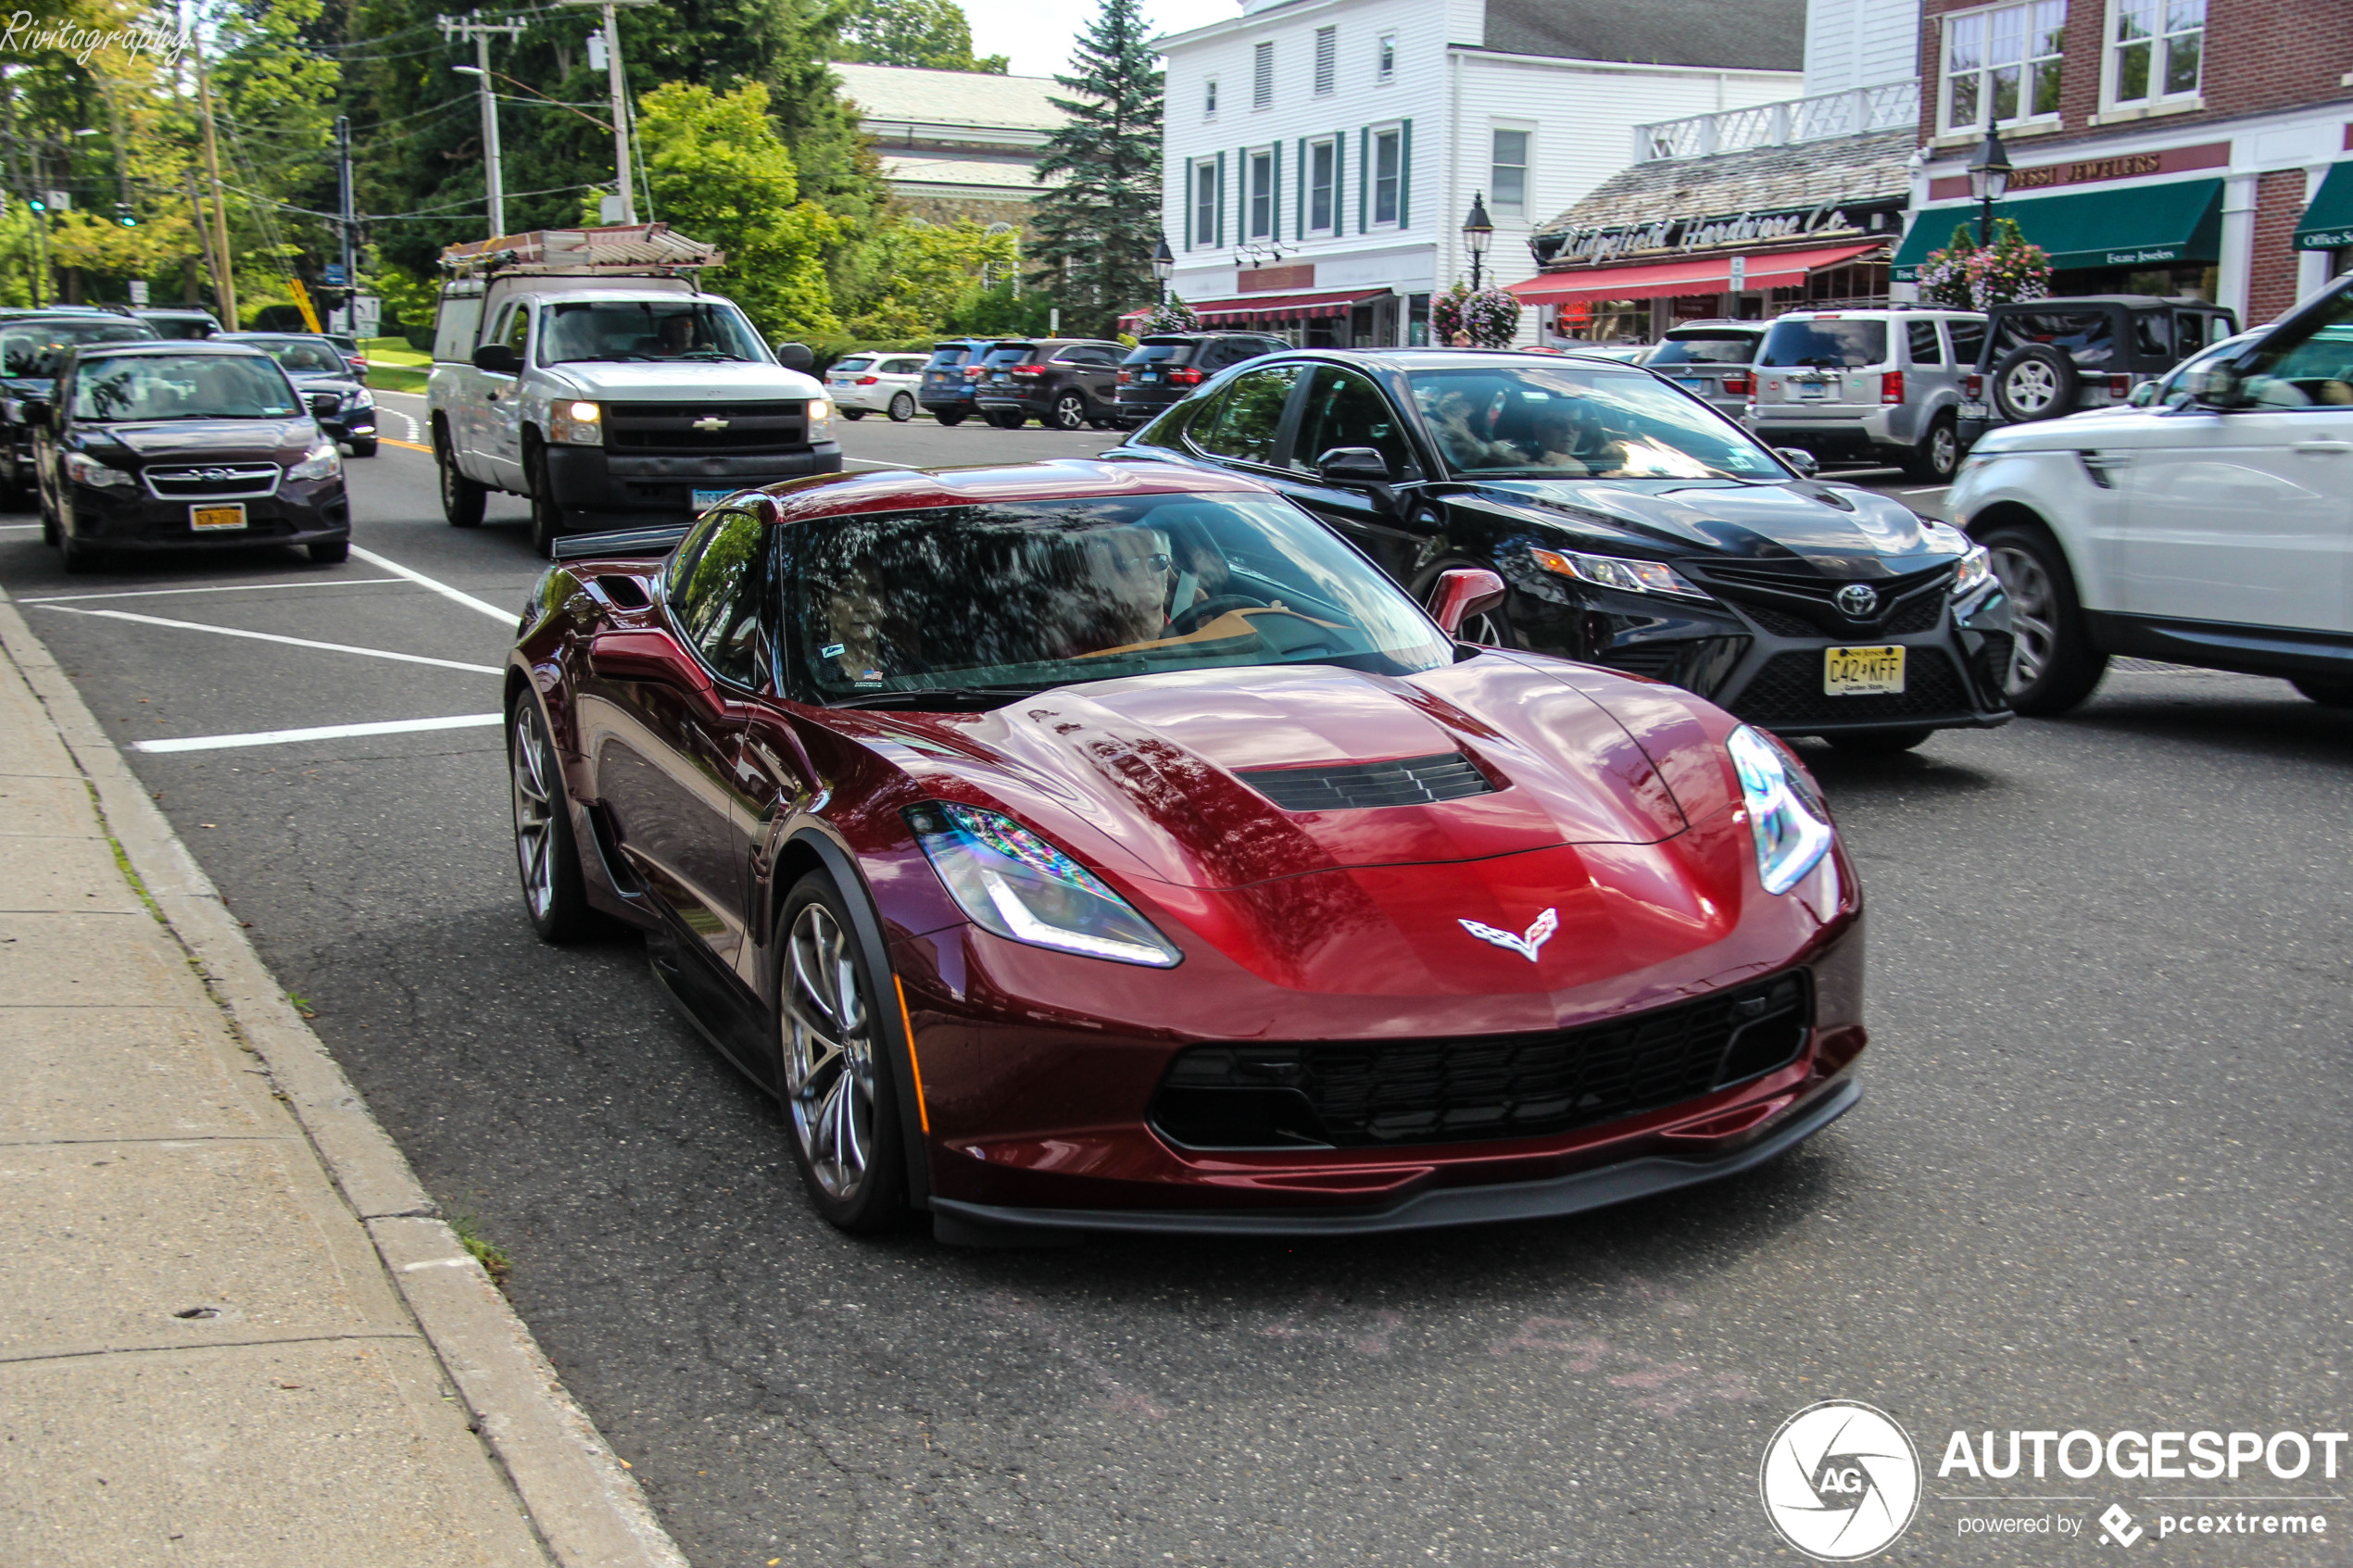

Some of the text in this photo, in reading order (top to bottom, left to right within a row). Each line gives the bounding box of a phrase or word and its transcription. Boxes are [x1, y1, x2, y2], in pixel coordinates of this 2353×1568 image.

[2007, 154, 2160, 189] DESSI JEWELERS
[1554, 218, 1676, 267] Ridgefield
[1679, 211, 1800, 254] Hardware
[2303, 232, 2342, 247] Office
